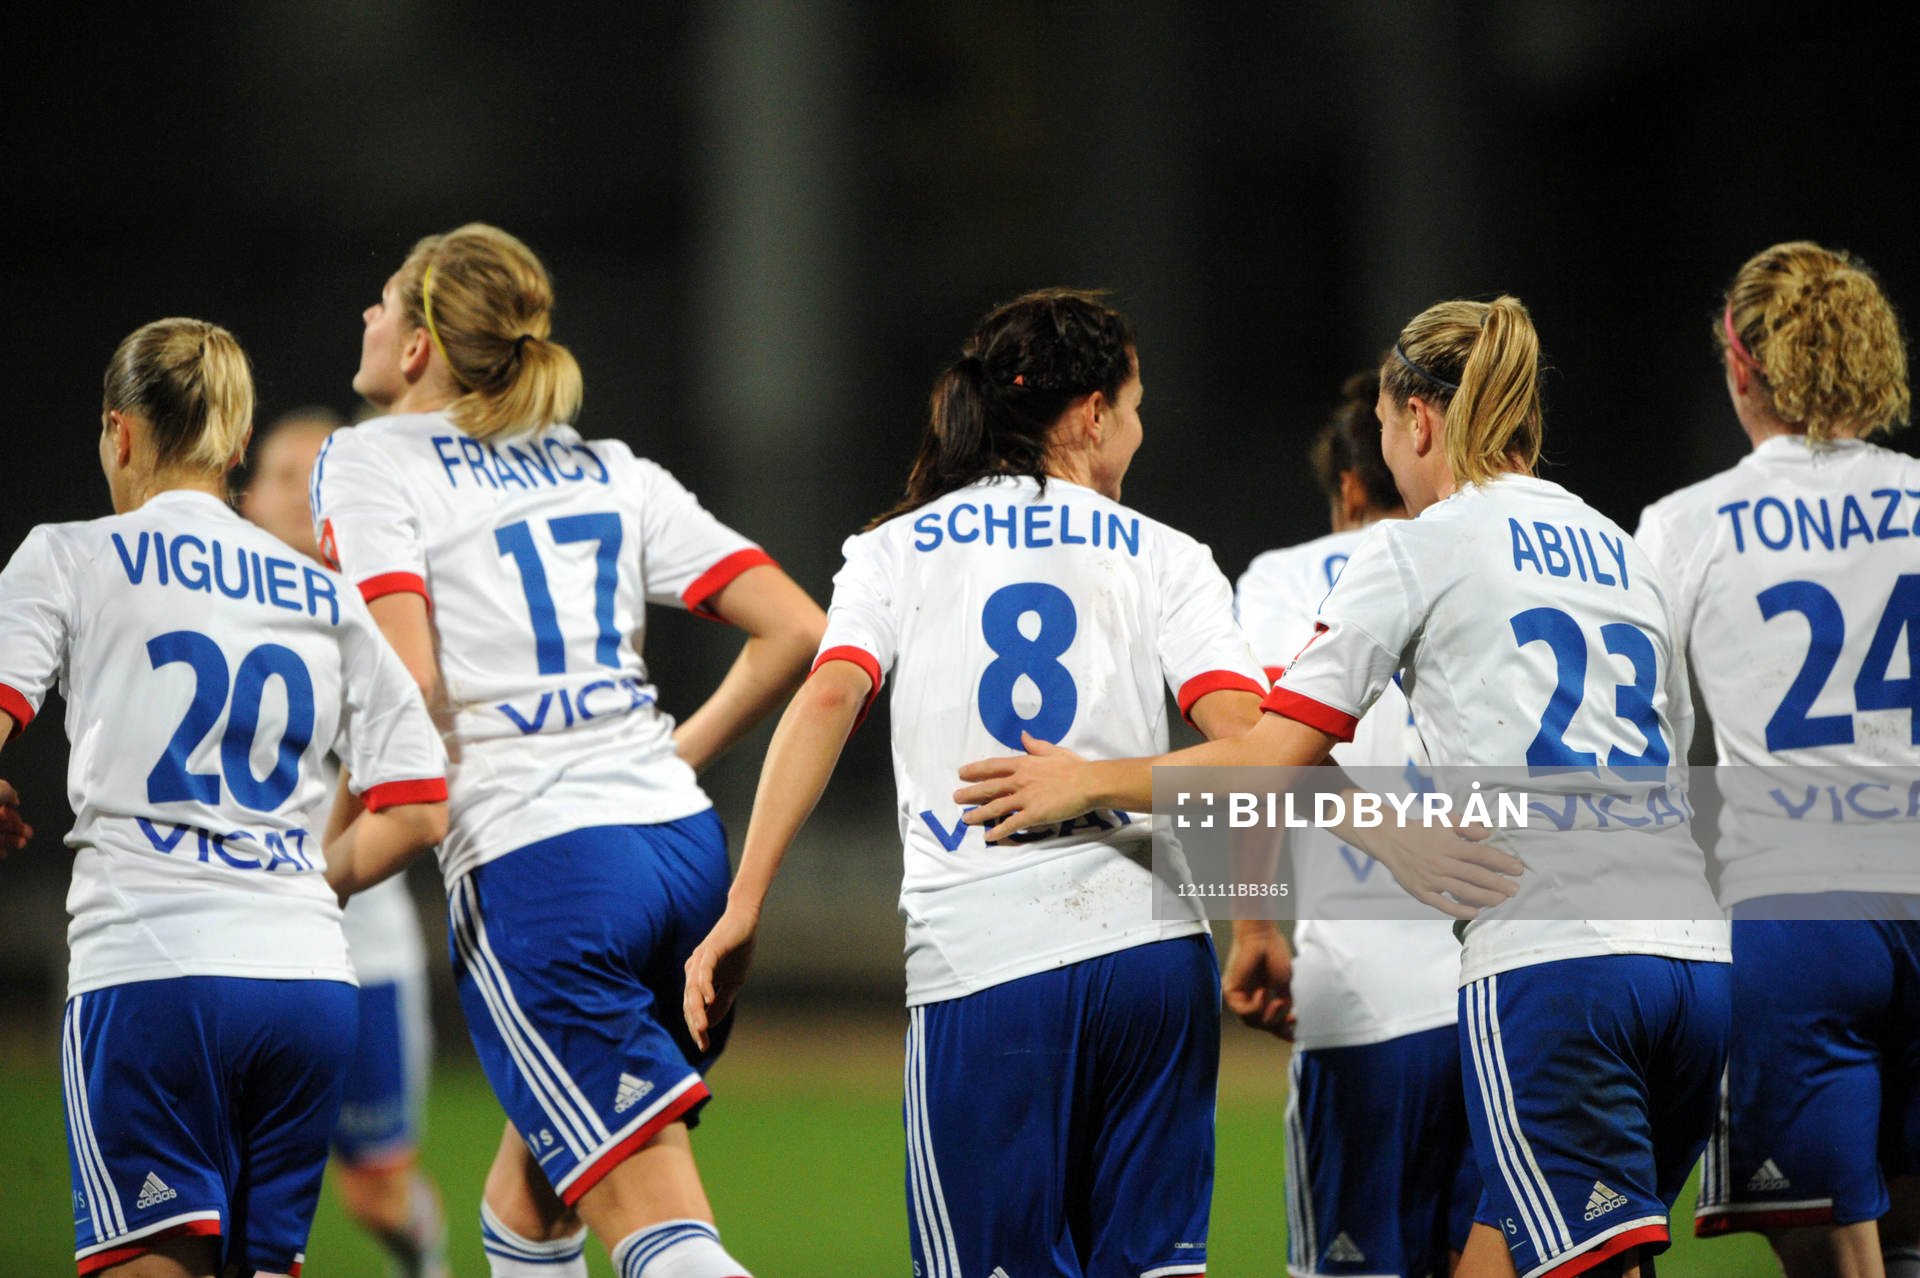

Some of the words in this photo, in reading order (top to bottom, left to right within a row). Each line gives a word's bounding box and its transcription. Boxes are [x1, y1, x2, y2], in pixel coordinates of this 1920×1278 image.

[914, 503, 1140, 557] SCHELIN
[1508, 517, 1630, 591] ABILY
[111, 531, 341, 626] VIGUIER
[494, 511, 623, 676] 17
[978, 582, 1077, 752] 8
[1509, 606, 1671, 783] 23
[1756, 573, 1920, 753] 24
[146, 630, 315, 813] 20
[134, 816, 314, 872] VICAT
[136, 1188, 178, 1209] adidas
[1583, 1194, 1628, 1221] adidas
